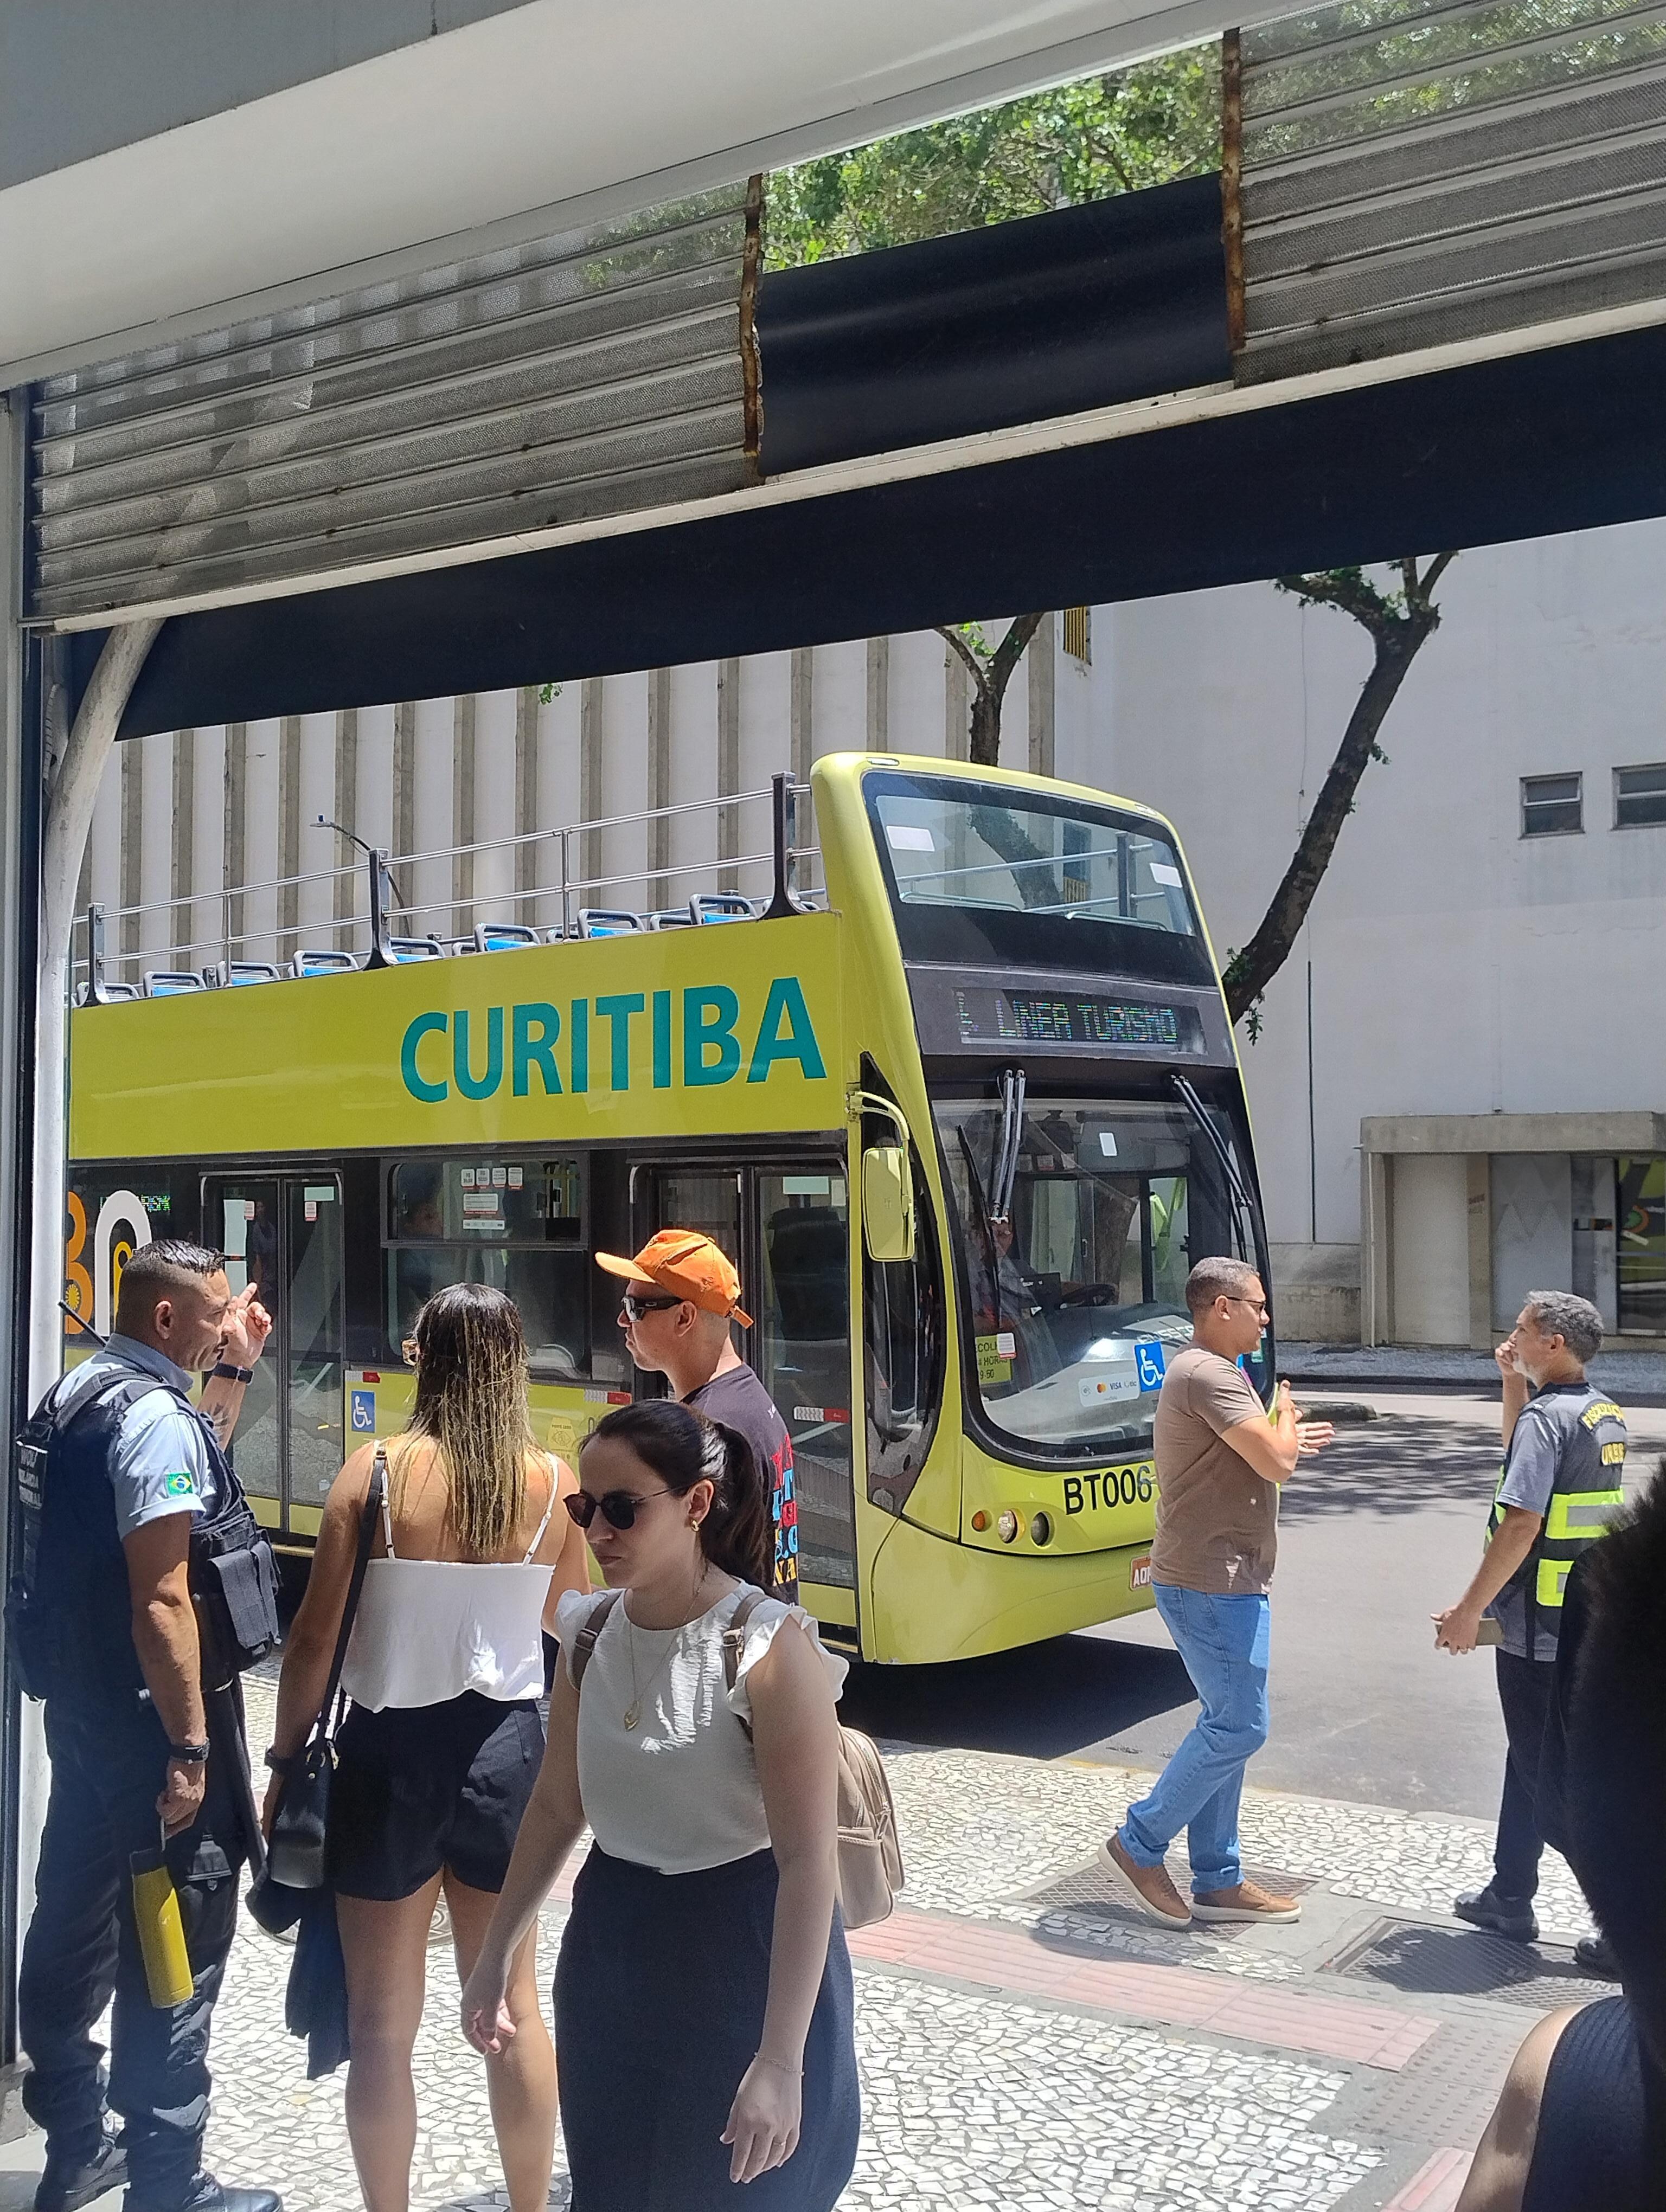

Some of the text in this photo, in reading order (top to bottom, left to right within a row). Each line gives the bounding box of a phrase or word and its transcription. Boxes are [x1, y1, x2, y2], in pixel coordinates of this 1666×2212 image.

[400, 976, 828, 1103] CURITIBA
[1110, 1381, 1122, 1390] VISA
[1063, 1465, 1152, 1515] BT006
